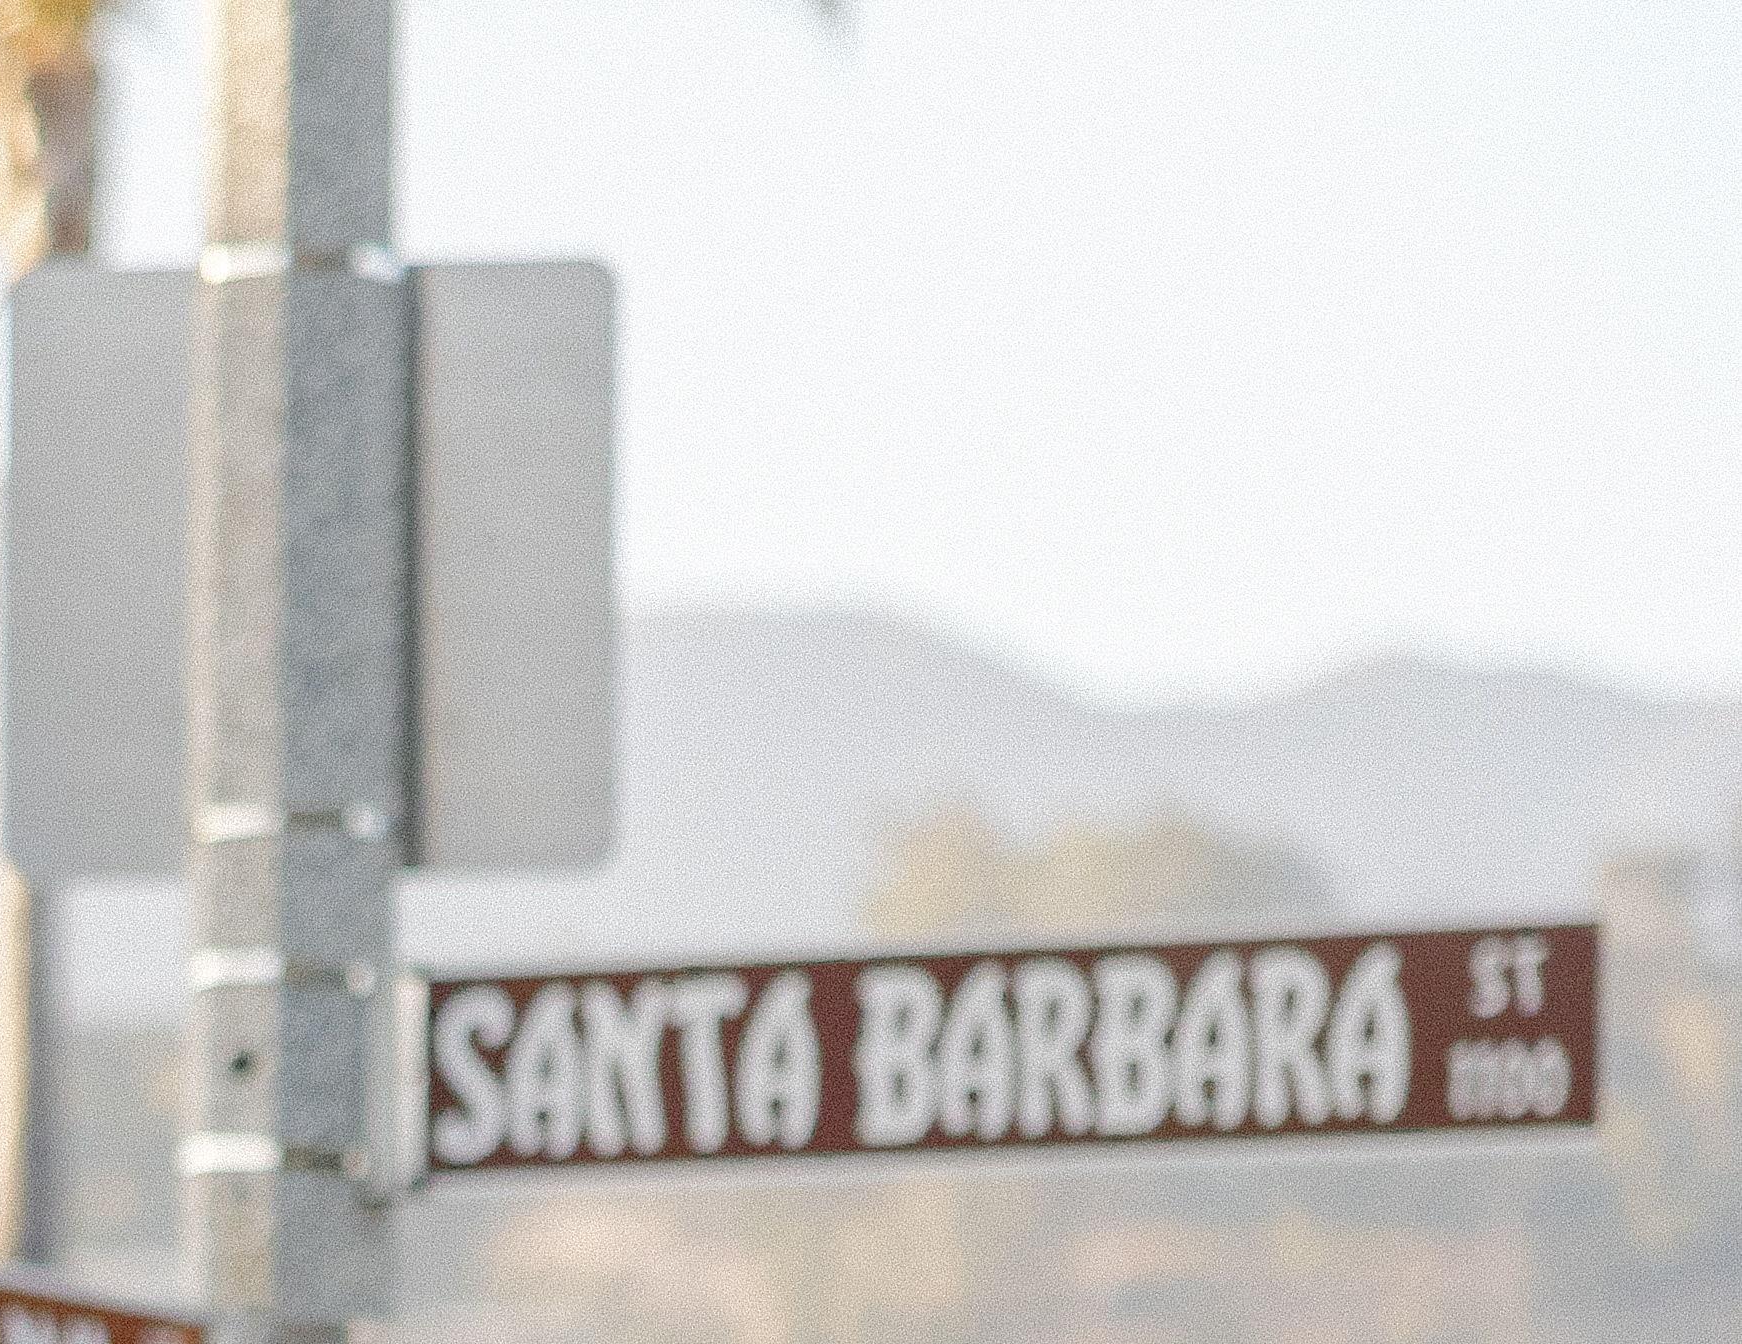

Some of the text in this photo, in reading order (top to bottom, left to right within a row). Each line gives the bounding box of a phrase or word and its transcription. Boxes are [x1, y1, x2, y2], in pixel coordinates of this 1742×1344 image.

[431, 935, 1551, 1167] SANTA BARBARA ST
